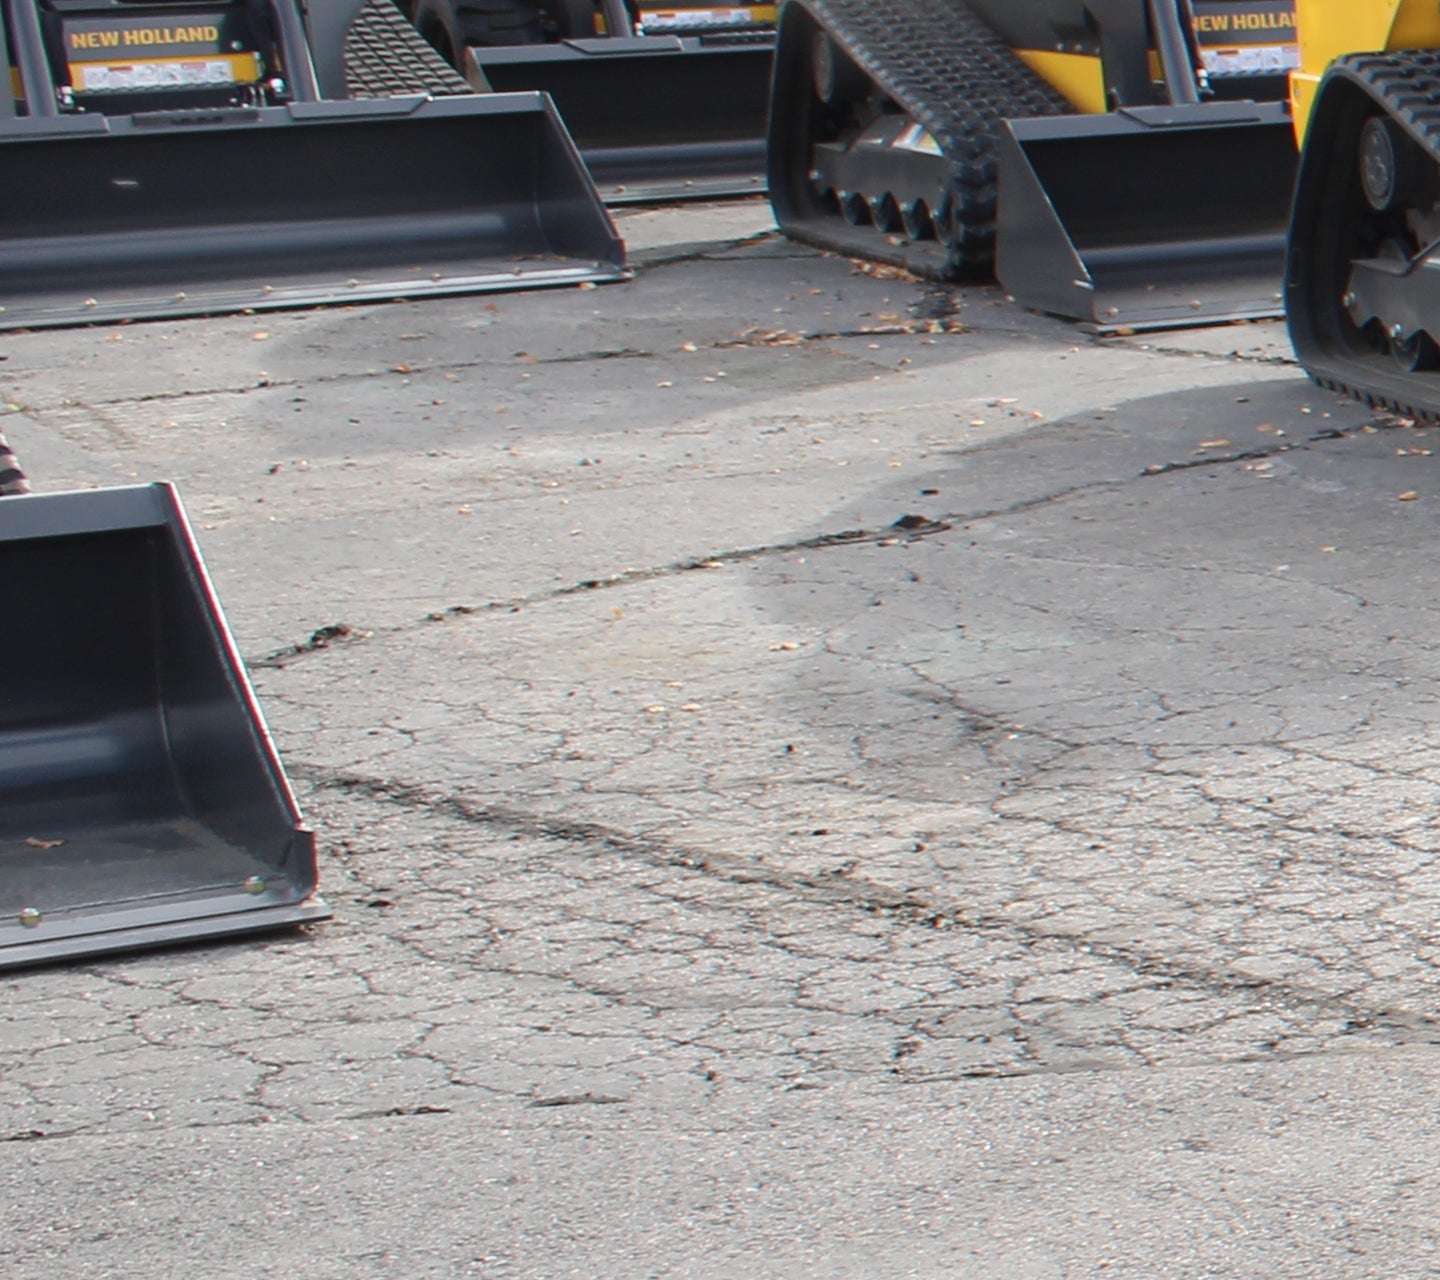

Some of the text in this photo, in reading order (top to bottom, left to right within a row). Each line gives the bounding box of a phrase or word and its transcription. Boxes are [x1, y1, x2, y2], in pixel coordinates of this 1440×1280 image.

[1232, 11, 1297, 30] HOLLA
[71, 25, 220, 50] NEW HOLLAND
